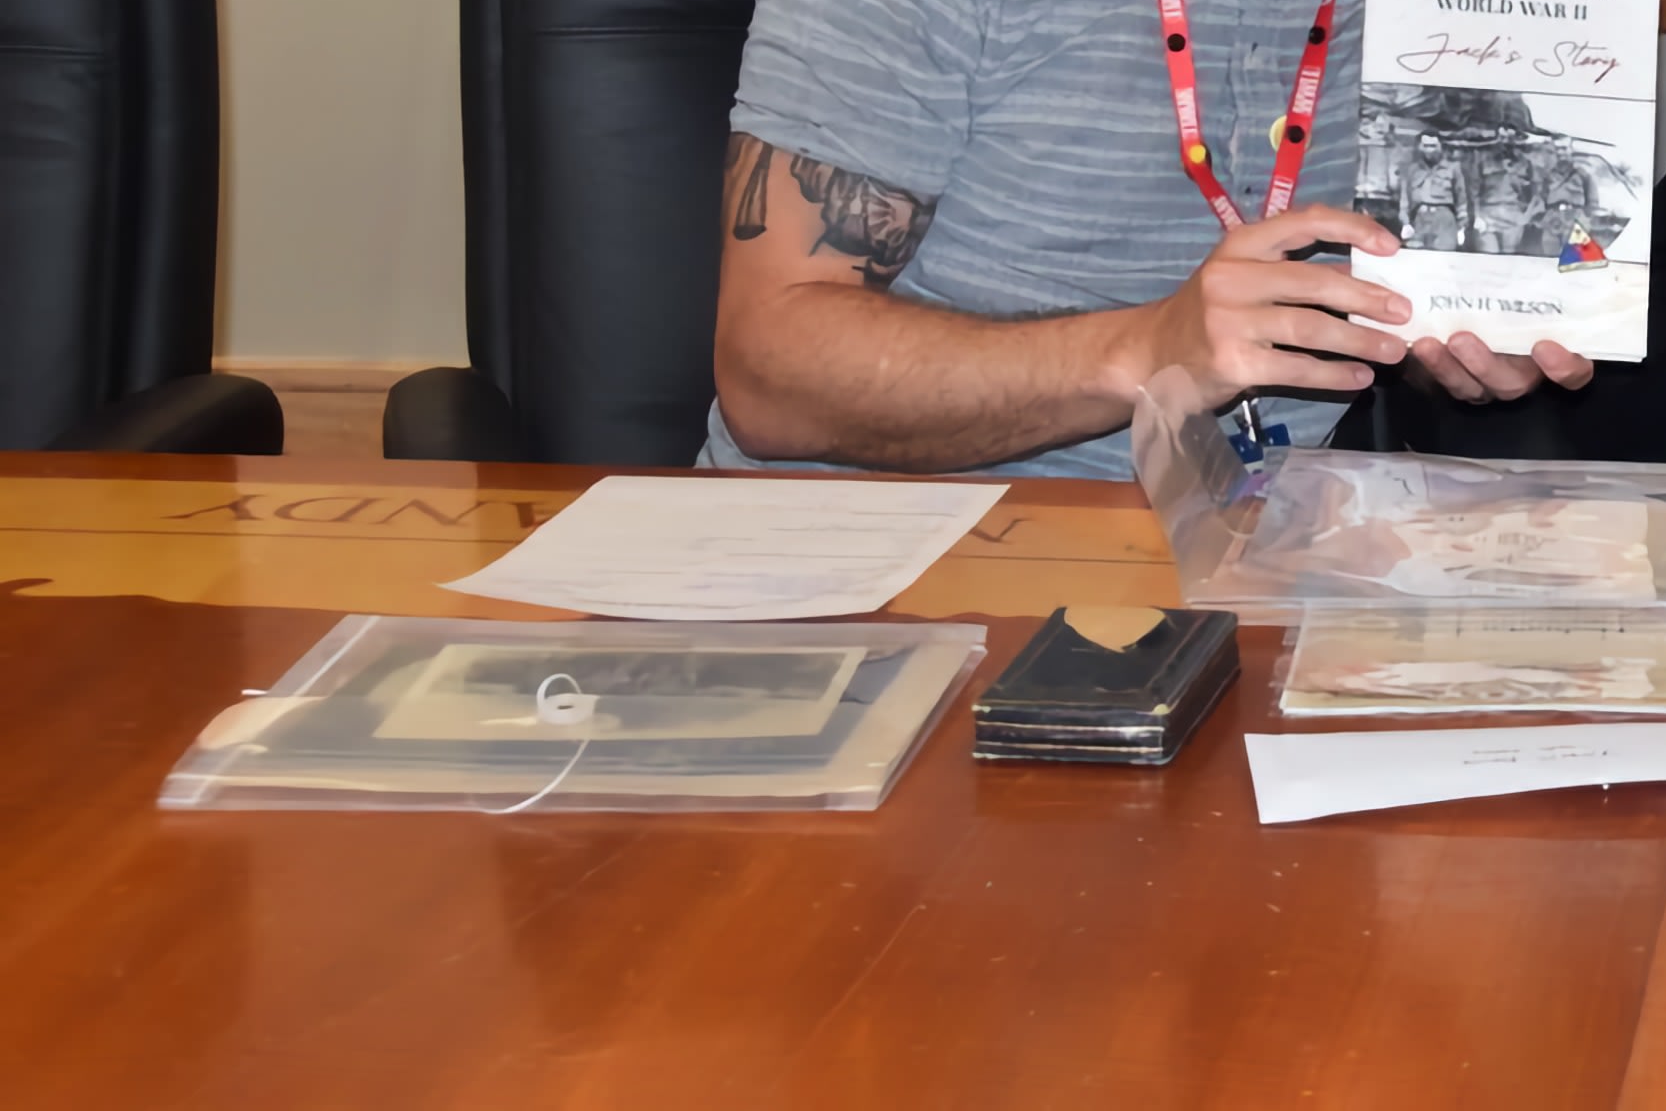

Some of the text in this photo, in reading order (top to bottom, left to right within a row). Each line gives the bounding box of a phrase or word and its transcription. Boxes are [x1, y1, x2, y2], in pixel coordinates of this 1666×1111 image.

[1519, 0, 1567, 19] WAR
[1573, 4, 1588, 21] II
[1396, 32, 1621, 84] Jack's Story
[1428, 295, 1473, 312] JOHN
